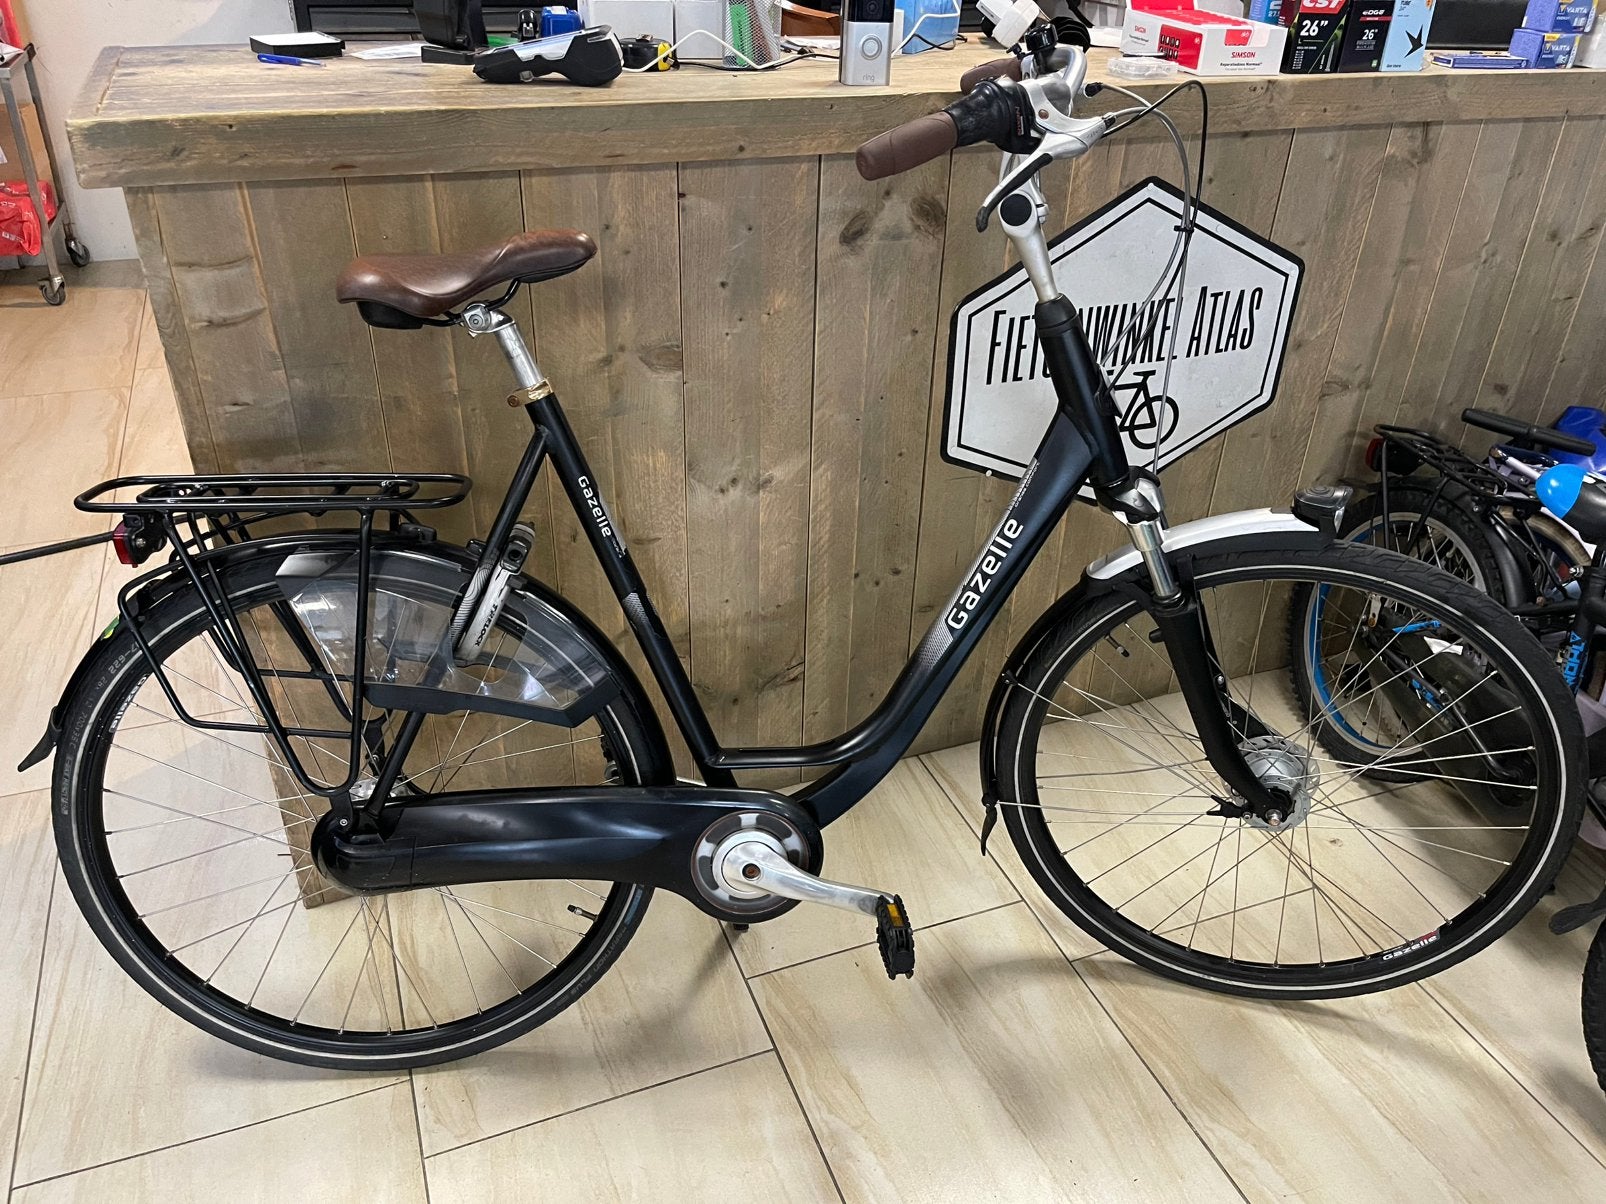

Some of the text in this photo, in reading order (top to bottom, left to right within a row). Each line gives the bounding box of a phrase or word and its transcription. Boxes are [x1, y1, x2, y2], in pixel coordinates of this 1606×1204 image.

[862, 73, 876, 83] ring
[1231, 51, 1256, 59] SIMSON
[1186, 286, 1263, 359] ATLAS
[578, 475, 612, 538] Gazelle
[947, 518, 1024, 630] Gazelle
